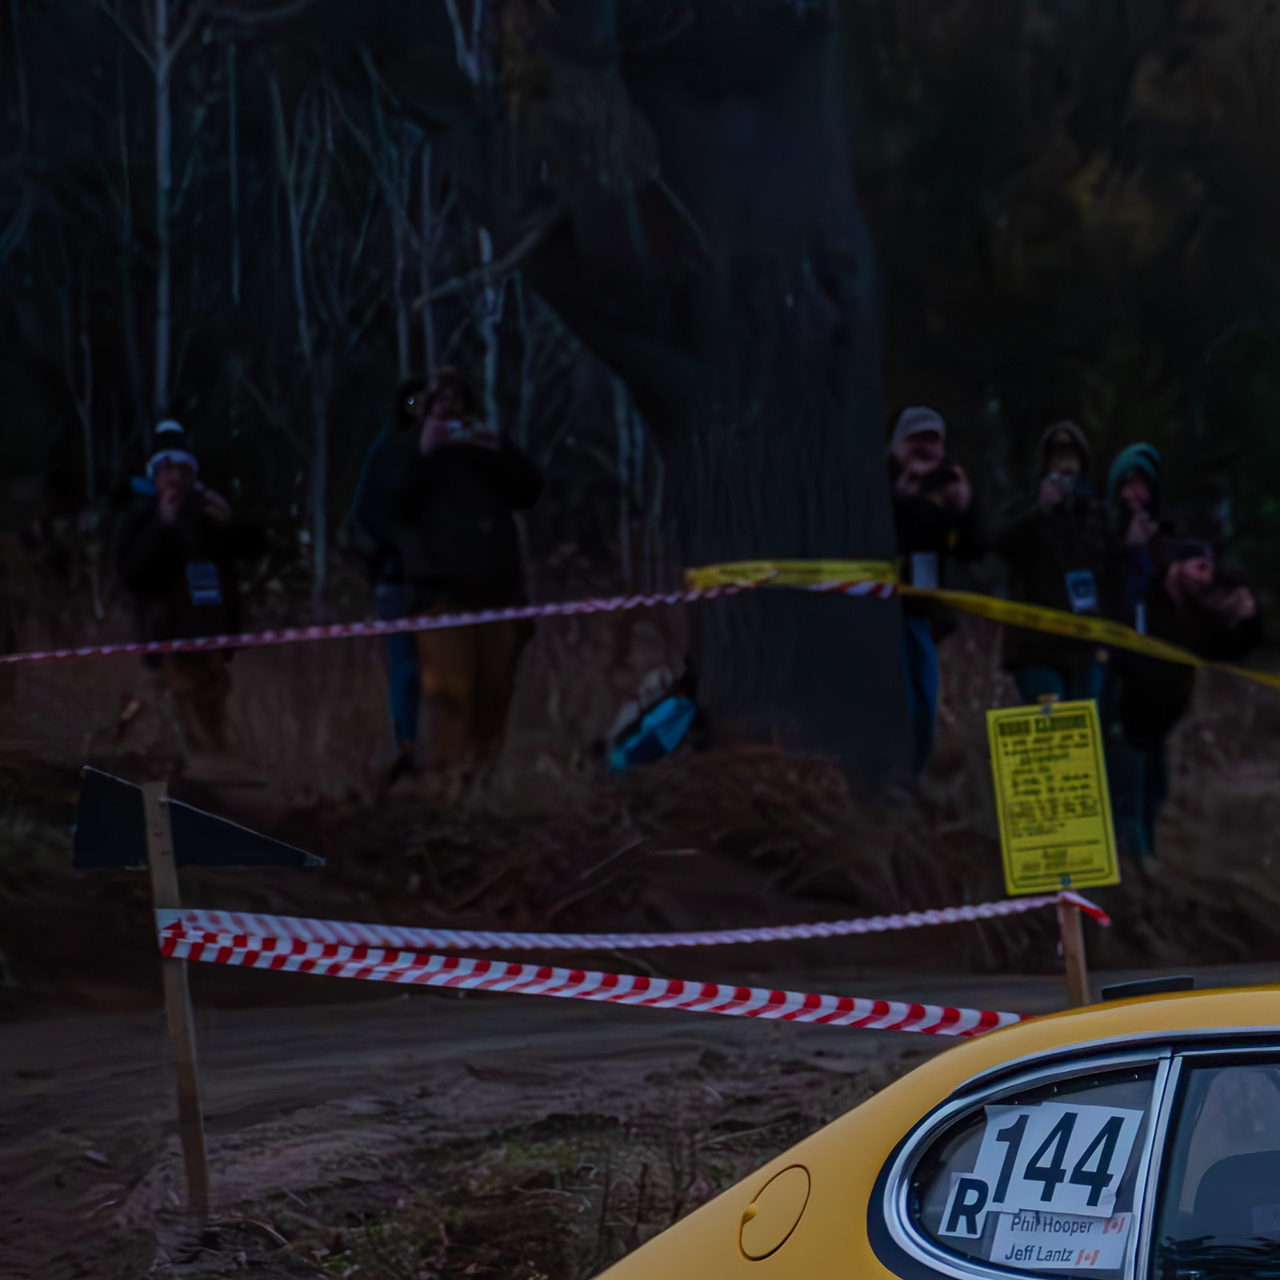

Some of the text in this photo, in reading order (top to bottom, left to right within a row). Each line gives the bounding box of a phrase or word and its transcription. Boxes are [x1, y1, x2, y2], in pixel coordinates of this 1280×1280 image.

[992, 1111, 1125, 1207] 144
[945, 1177, 990, 1236] R
[1042, 1216, 1094, 1238] Hooper
[1004, 1245, 1074, 1264] Jeff Lantz
